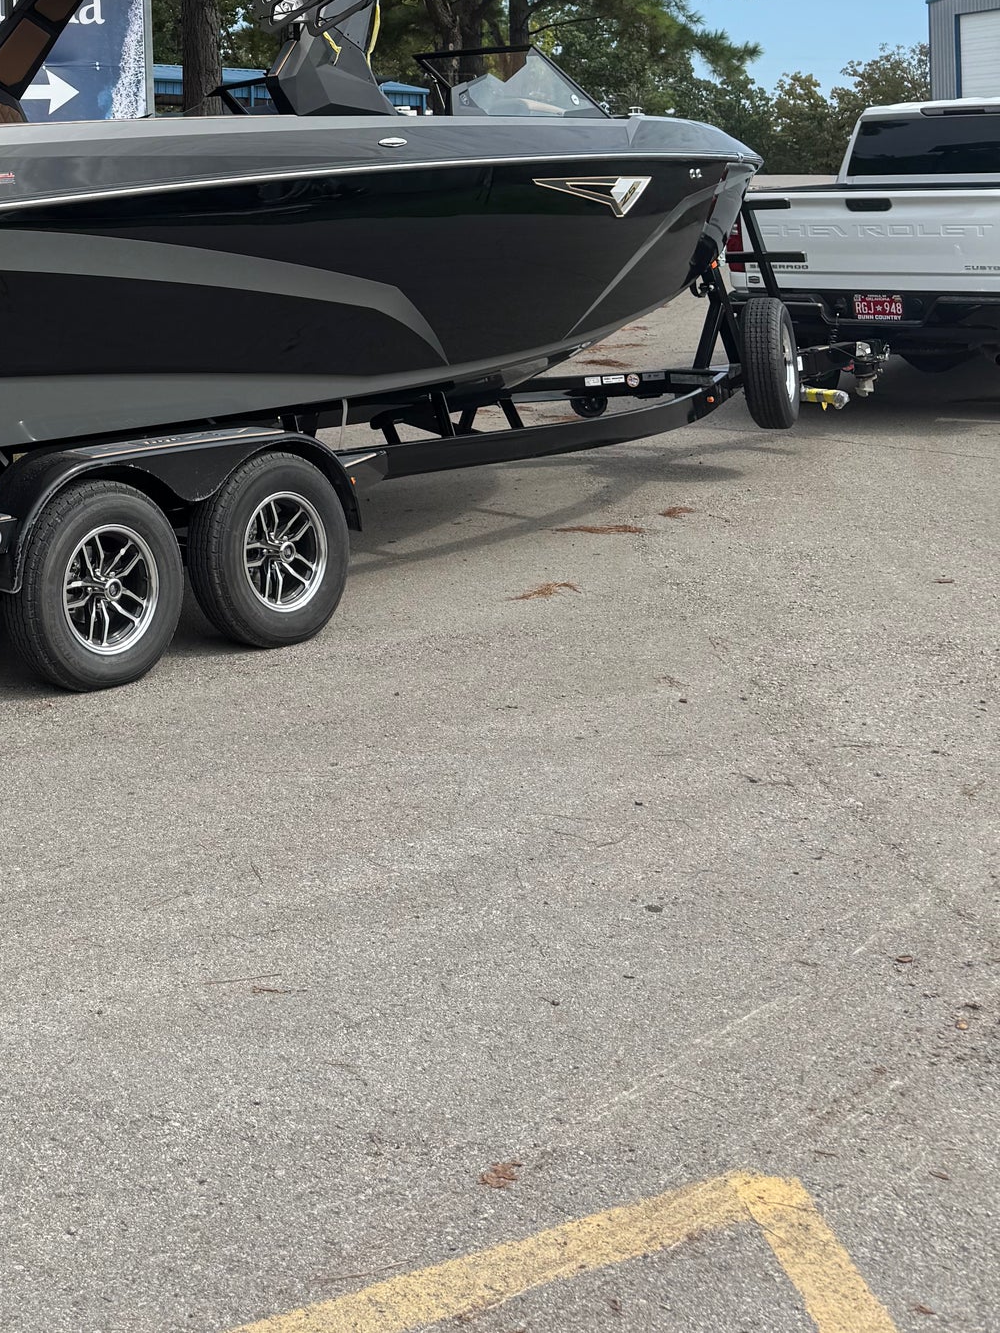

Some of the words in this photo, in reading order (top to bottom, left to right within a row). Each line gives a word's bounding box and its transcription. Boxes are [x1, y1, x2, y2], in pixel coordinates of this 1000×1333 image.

[760, 223, 994, 238] CHEVROLET
[855, 301, 874, 314] RGJ
[883, 302, 903, 315] 948
